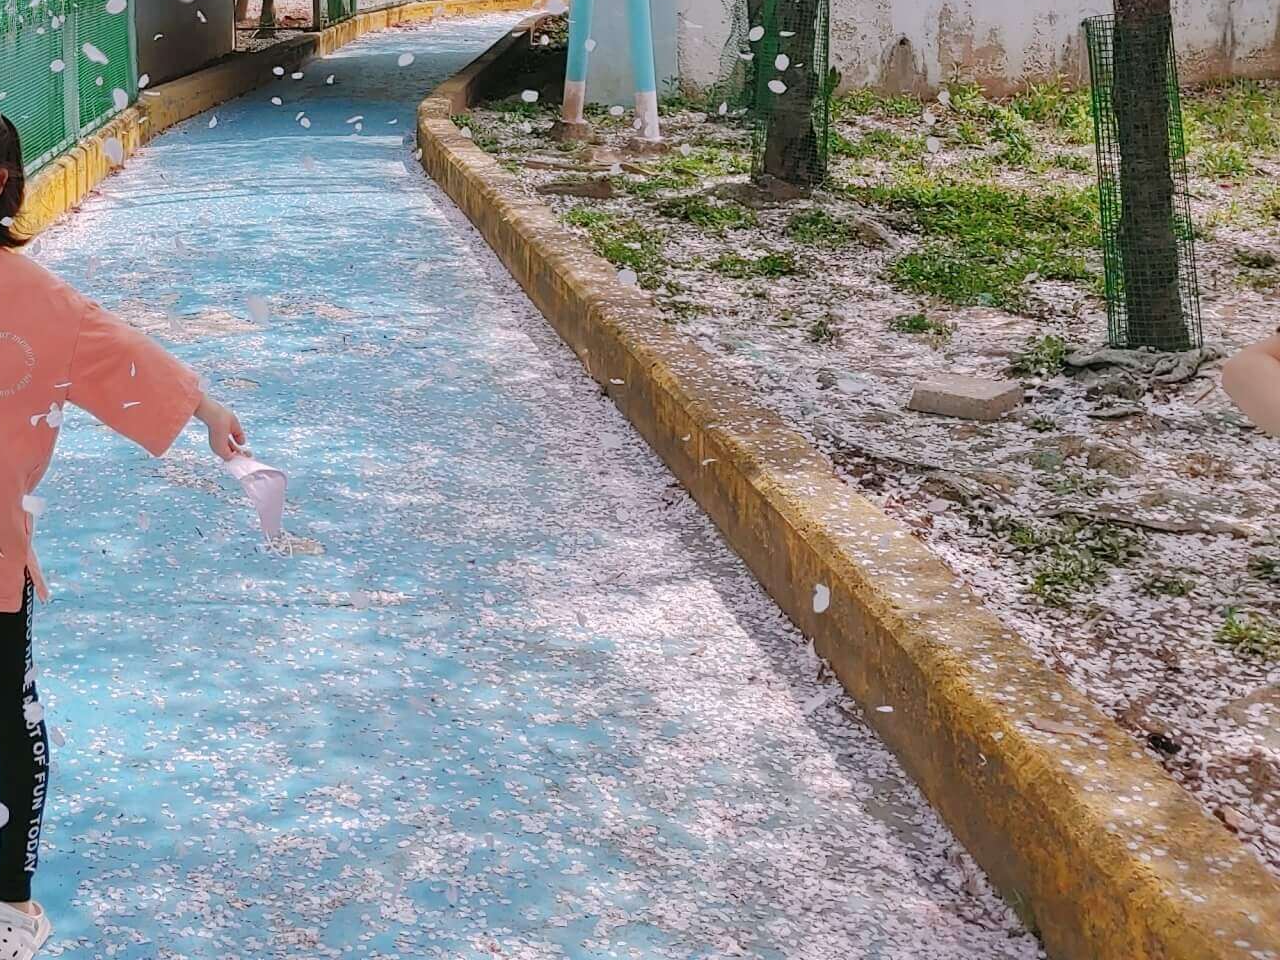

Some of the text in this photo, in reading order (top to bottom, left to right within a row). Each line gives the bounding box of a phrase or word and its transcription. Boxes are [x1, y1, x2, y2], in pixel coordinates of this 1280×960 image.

[22, 646, 34, 693] HAE
[32, 741, 46, 767] OF
[31, 771, 46, 811] FUN
[23, 813, 41, 872] TODAY
